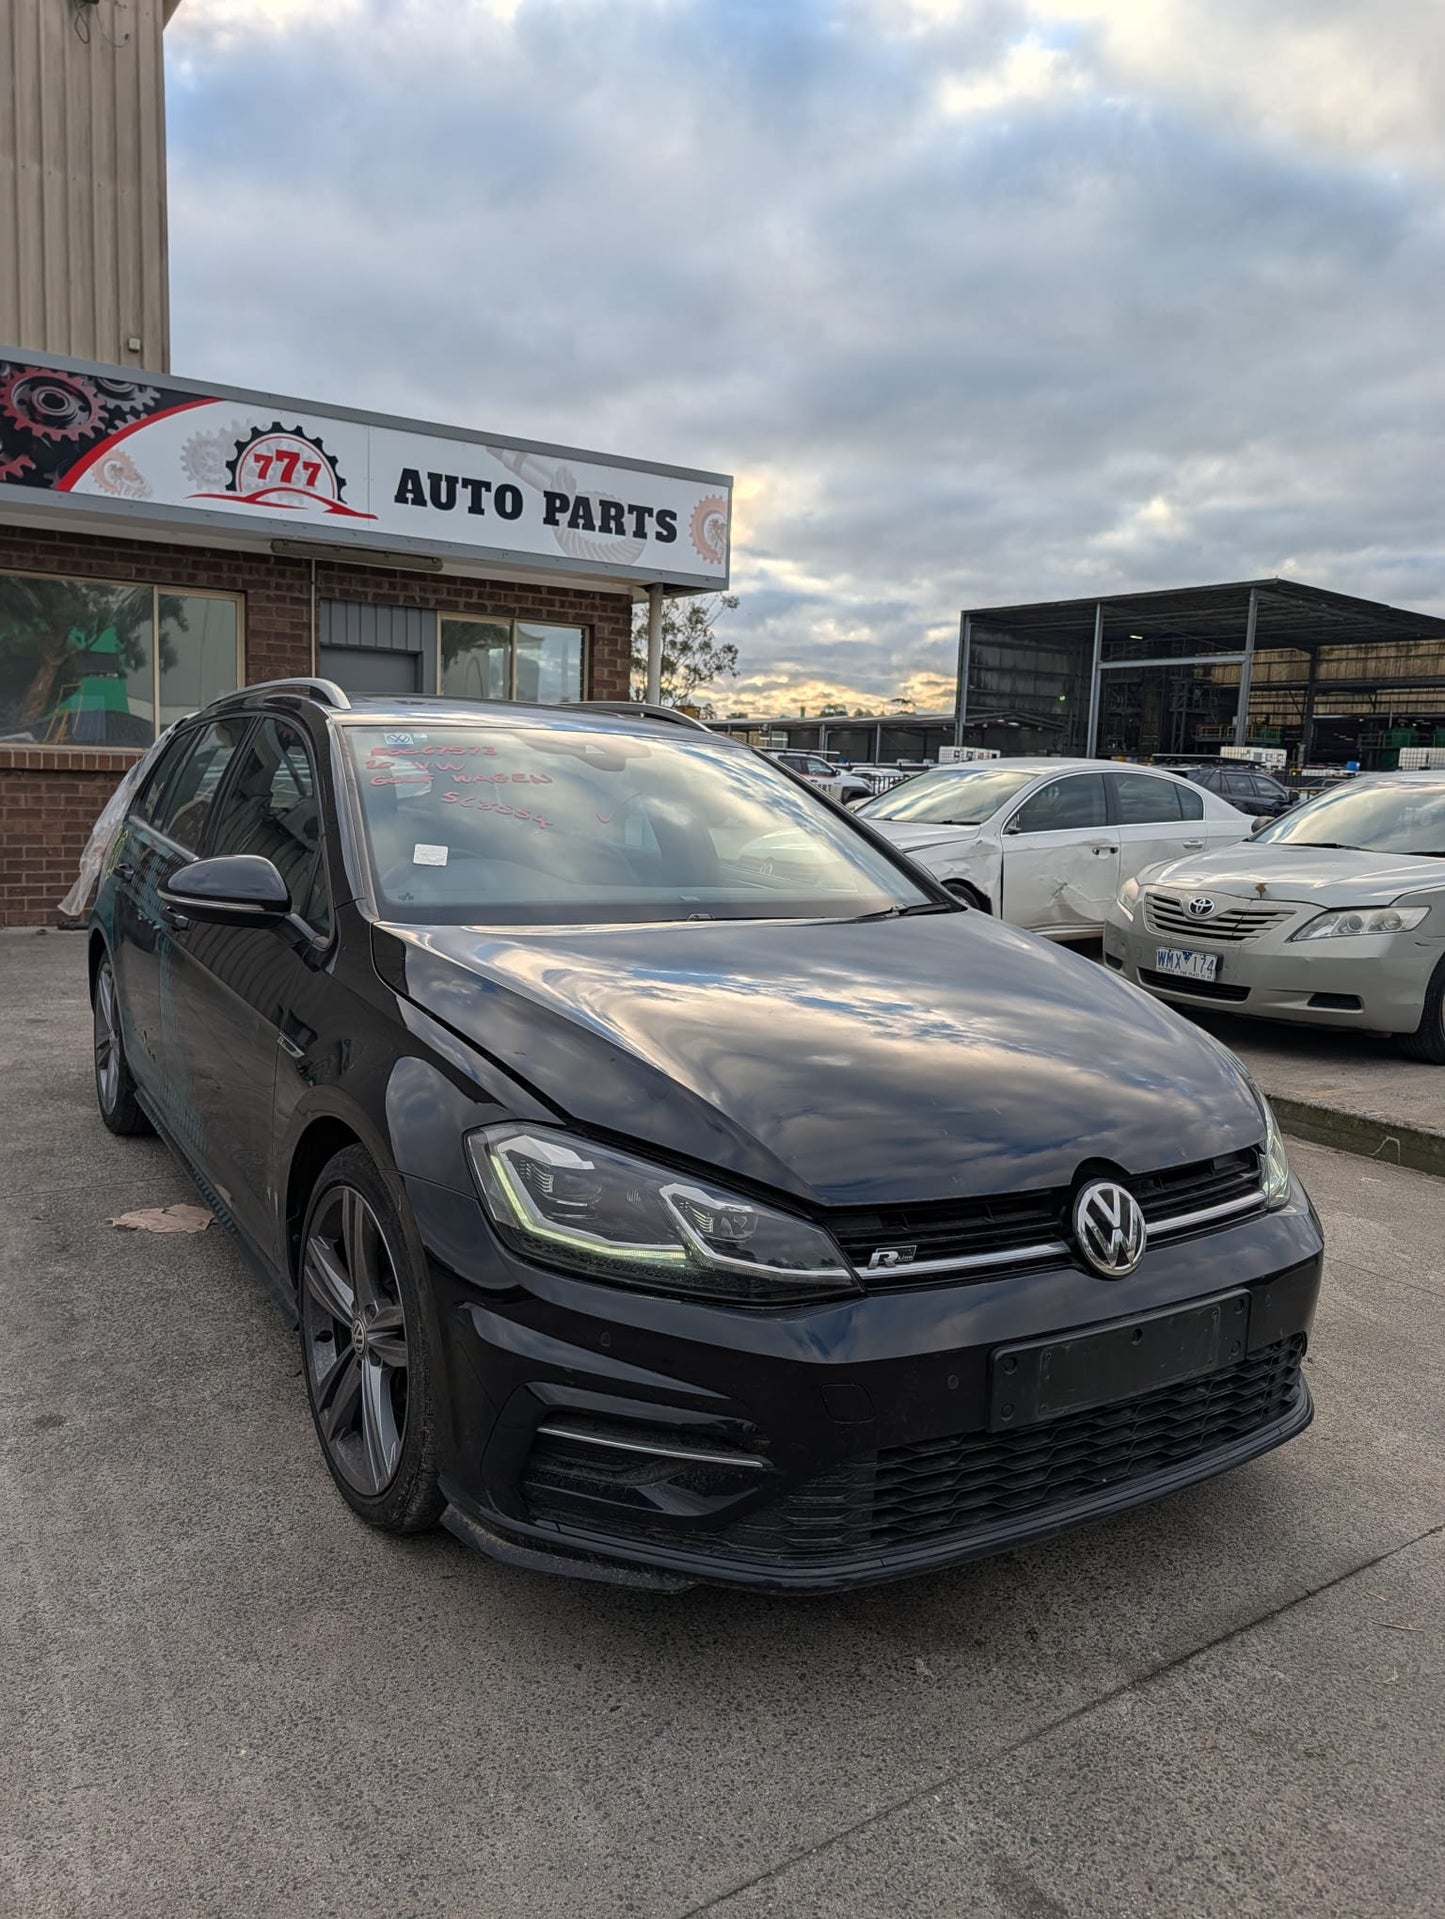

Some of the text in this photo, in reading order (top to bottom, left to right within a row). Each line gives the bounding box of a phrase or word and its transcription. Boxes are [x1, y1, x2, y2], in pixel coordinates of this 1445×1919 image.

[254, 449, 321, 487] 777
[394, 468, 677, 543] AUTO PARTS
[1157, 950, 1214, 975] WMX 174
